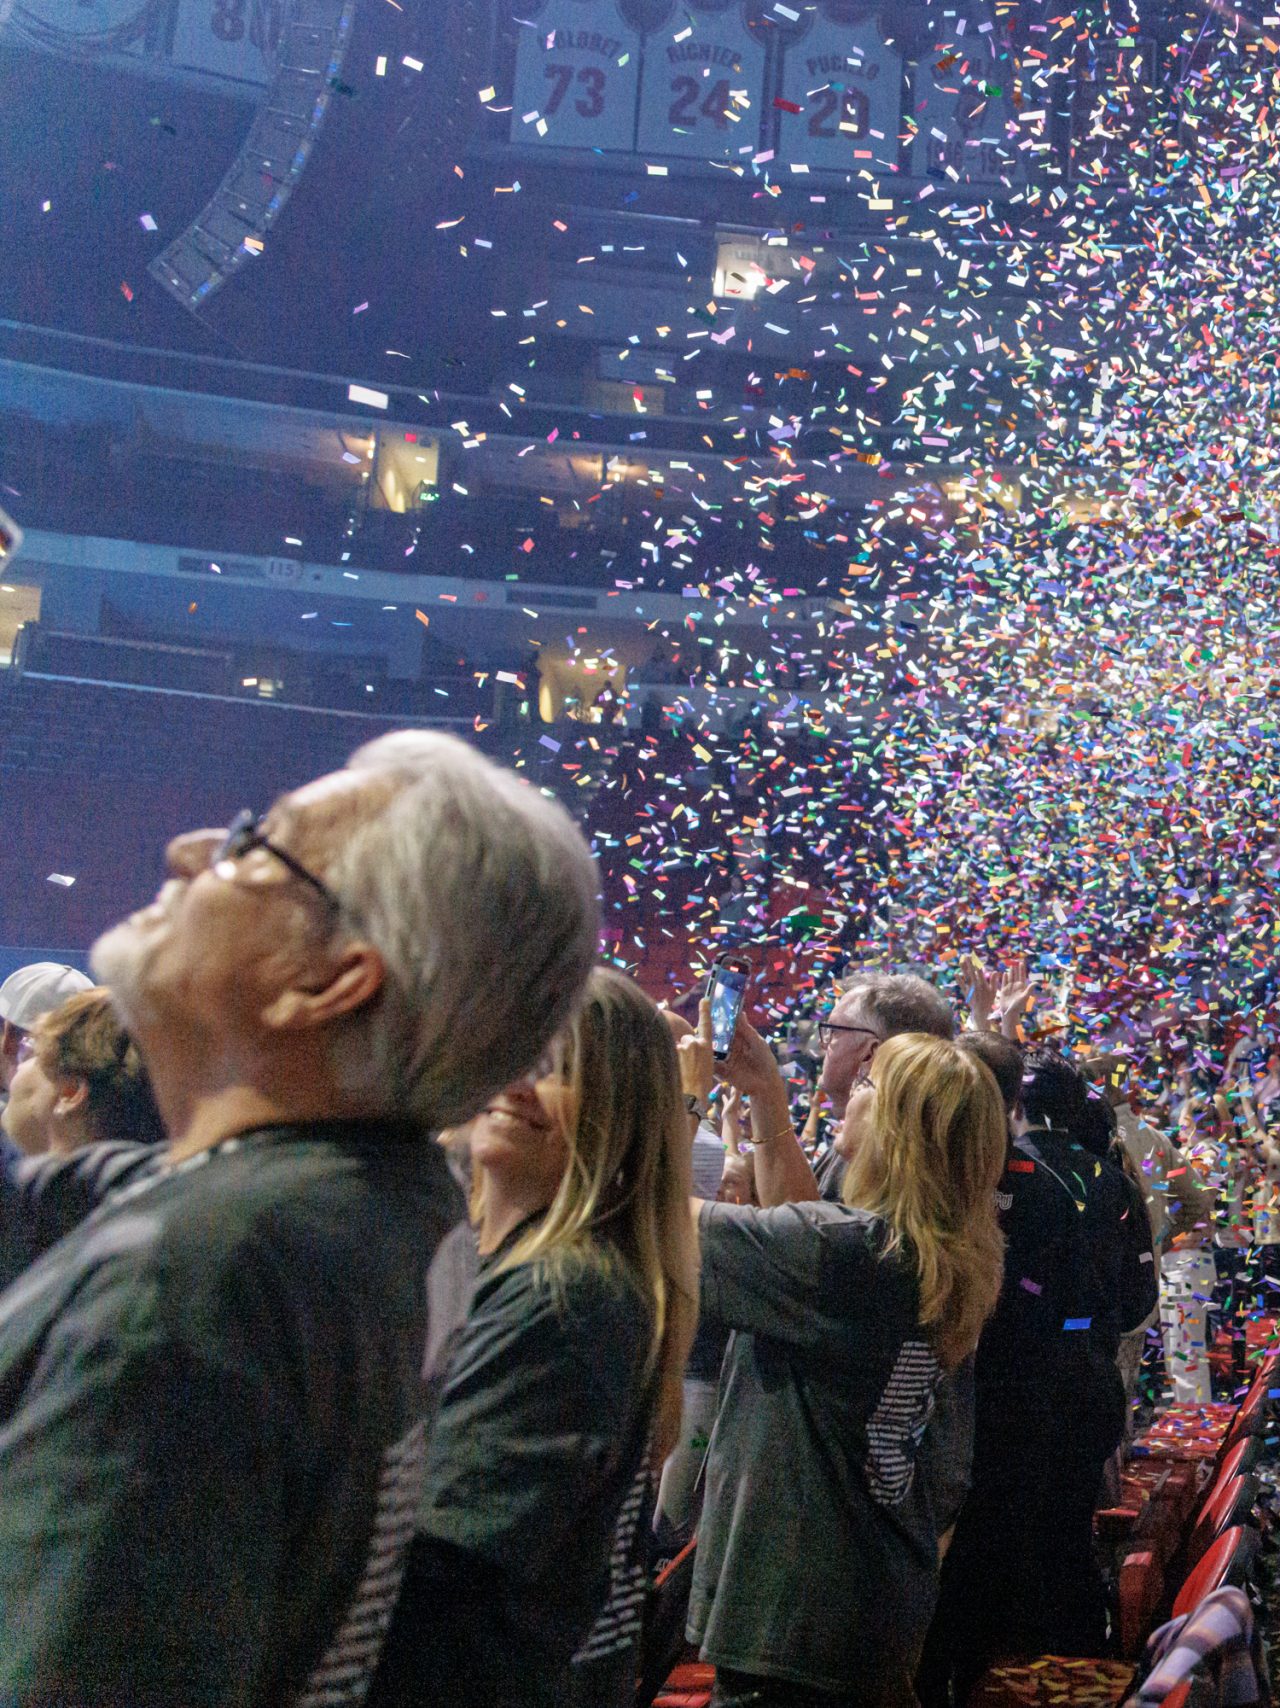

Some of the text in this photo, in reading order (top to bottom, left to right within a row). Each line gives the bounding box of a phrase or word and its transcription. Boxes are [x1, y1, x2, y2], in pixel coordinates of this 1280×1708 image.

[542, 63, 607, 119] 73
[668, 75, 732, 129] 24
[808, 87, 871, 140] 20
[270, 561, 294, 577] 115
